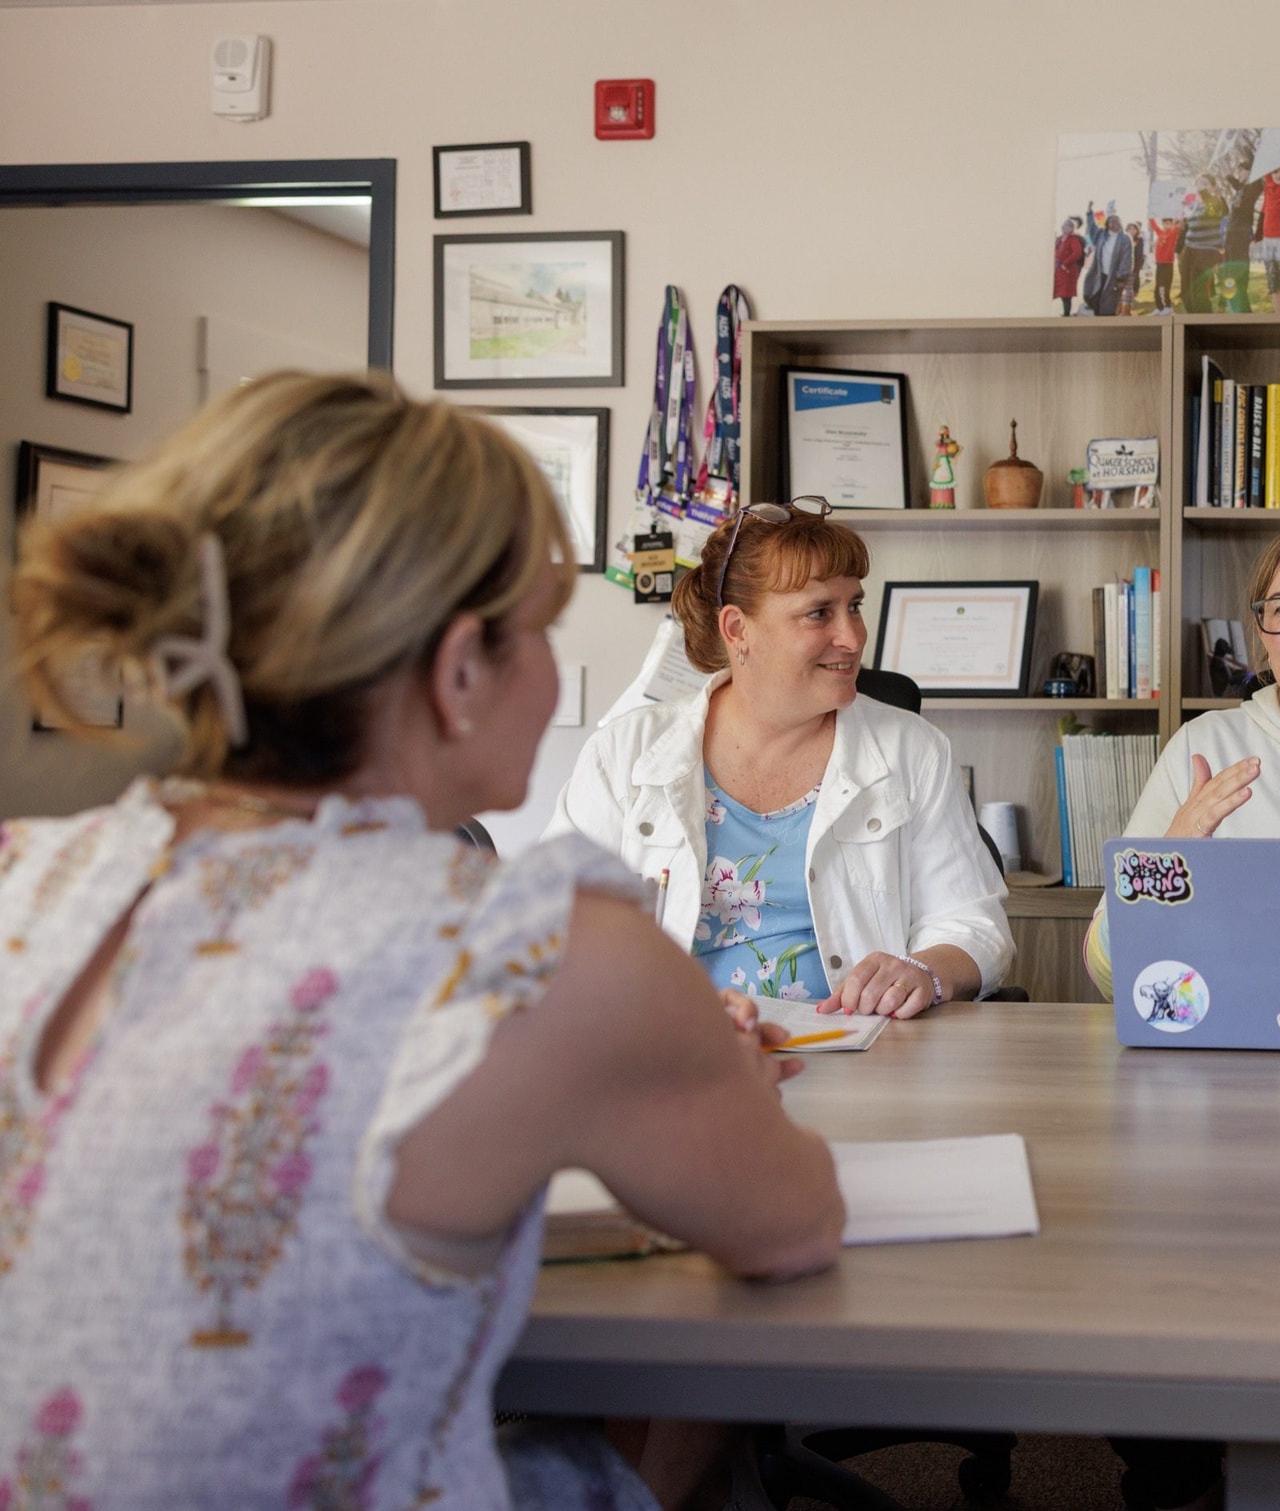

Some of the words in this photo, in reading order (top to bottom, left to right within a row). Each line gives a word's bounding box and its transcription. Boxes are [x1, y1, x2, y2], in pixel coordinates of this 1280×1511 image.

[801, 385, 849, 397] Certificate
[1253, 396, 1263, 426] RAISE
[1252, 437, 1262, 458] BAR
[1090, 454, 1122, 469] QUAKER
[1122, 457, 1155, 468] SCHOOL
[1103, 464, 1155, 477] HORSHAM
